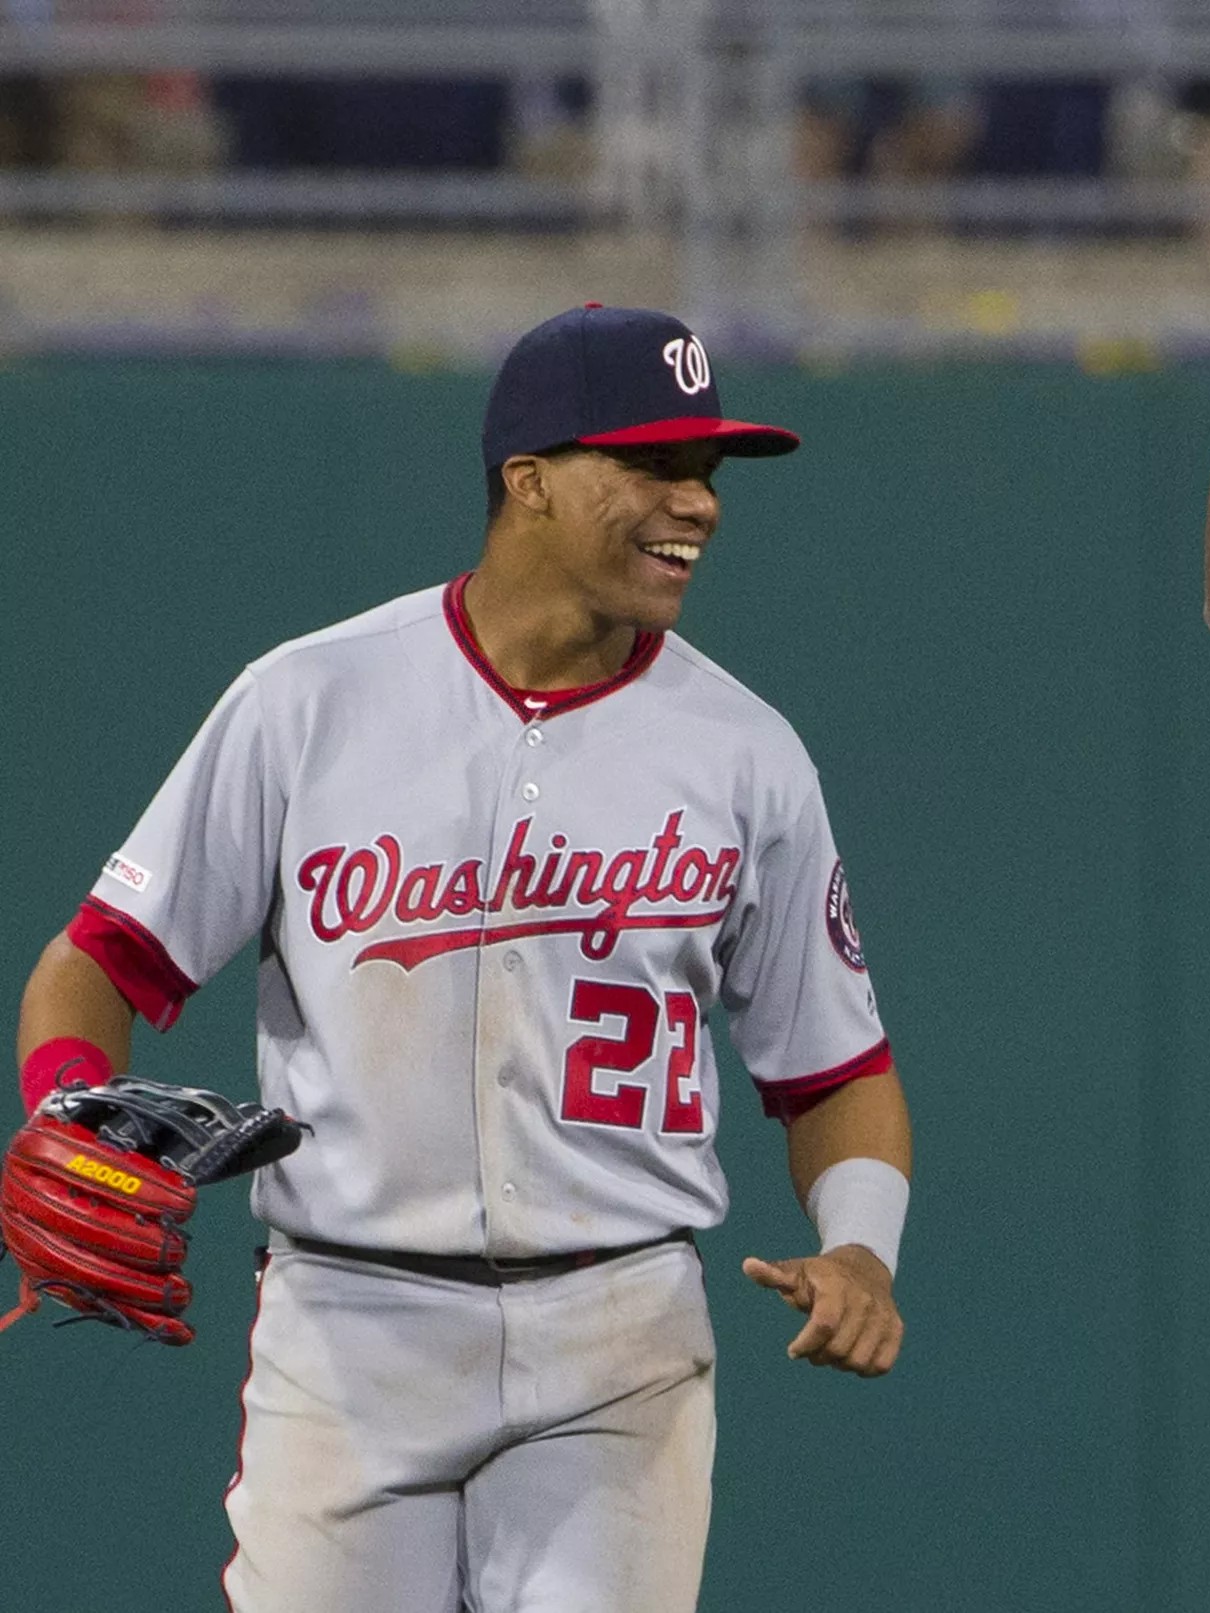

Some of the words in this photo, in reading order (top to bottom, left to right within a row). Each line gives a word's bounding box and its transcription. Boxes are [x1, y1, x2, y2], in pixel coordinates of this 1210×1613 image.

[663, 335, 711, 395] W
[297, 805, 742, 974] Washington
[559, 974, 706, 1137] 22
[64, 1153, 144, 1196] A2000
